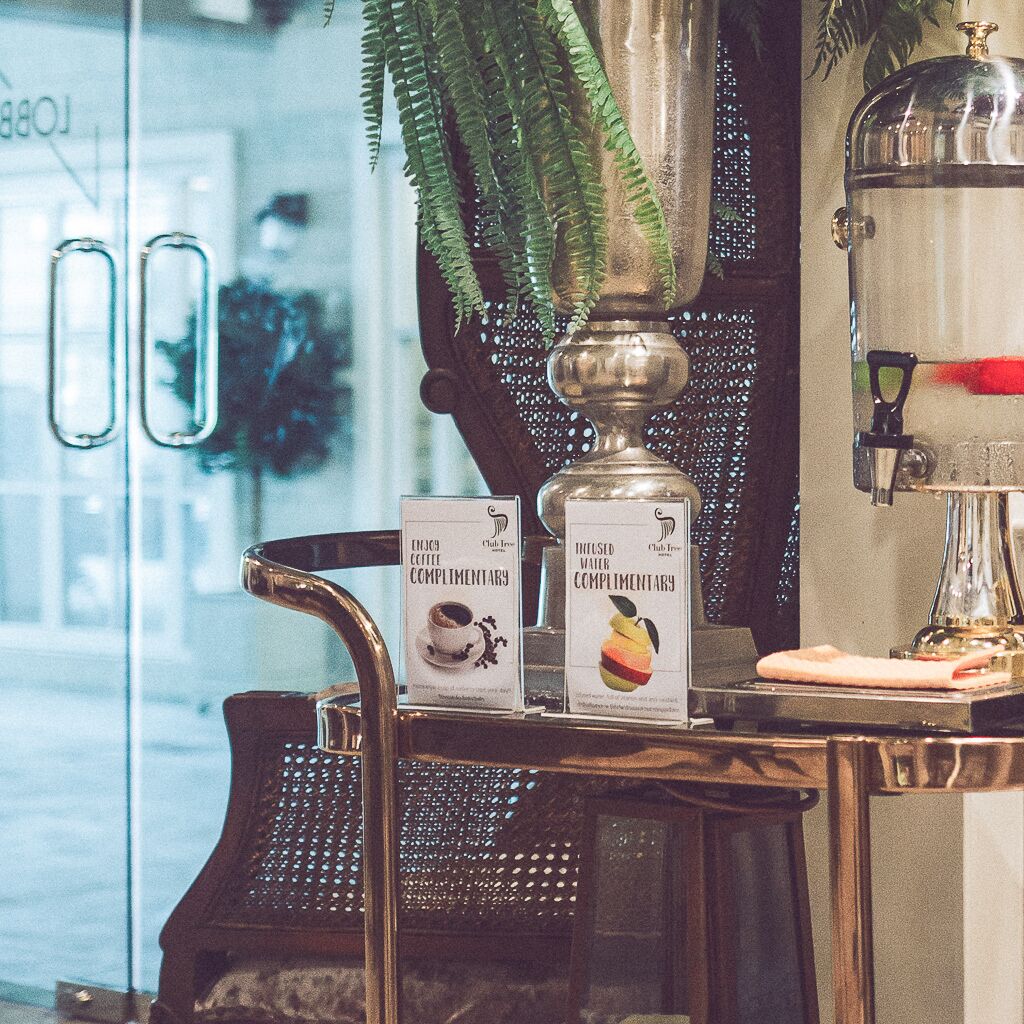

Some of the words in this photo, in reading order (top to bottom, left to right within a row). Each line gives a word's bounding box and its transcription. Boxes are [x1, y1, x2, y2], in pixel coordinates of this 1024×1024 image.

[411, 539, 440, 552] ENJOY
[575, 542, 615, 556] INFUSED
[648, 543, 666, 552] Club
[410, 553, 441, 566] COFFEE
[580, 557, 610, 571] WATER
[410, 567, 509, 587] COMPLIMENTARY
[574, 571, 675, 592] COMPLIMENTARY
